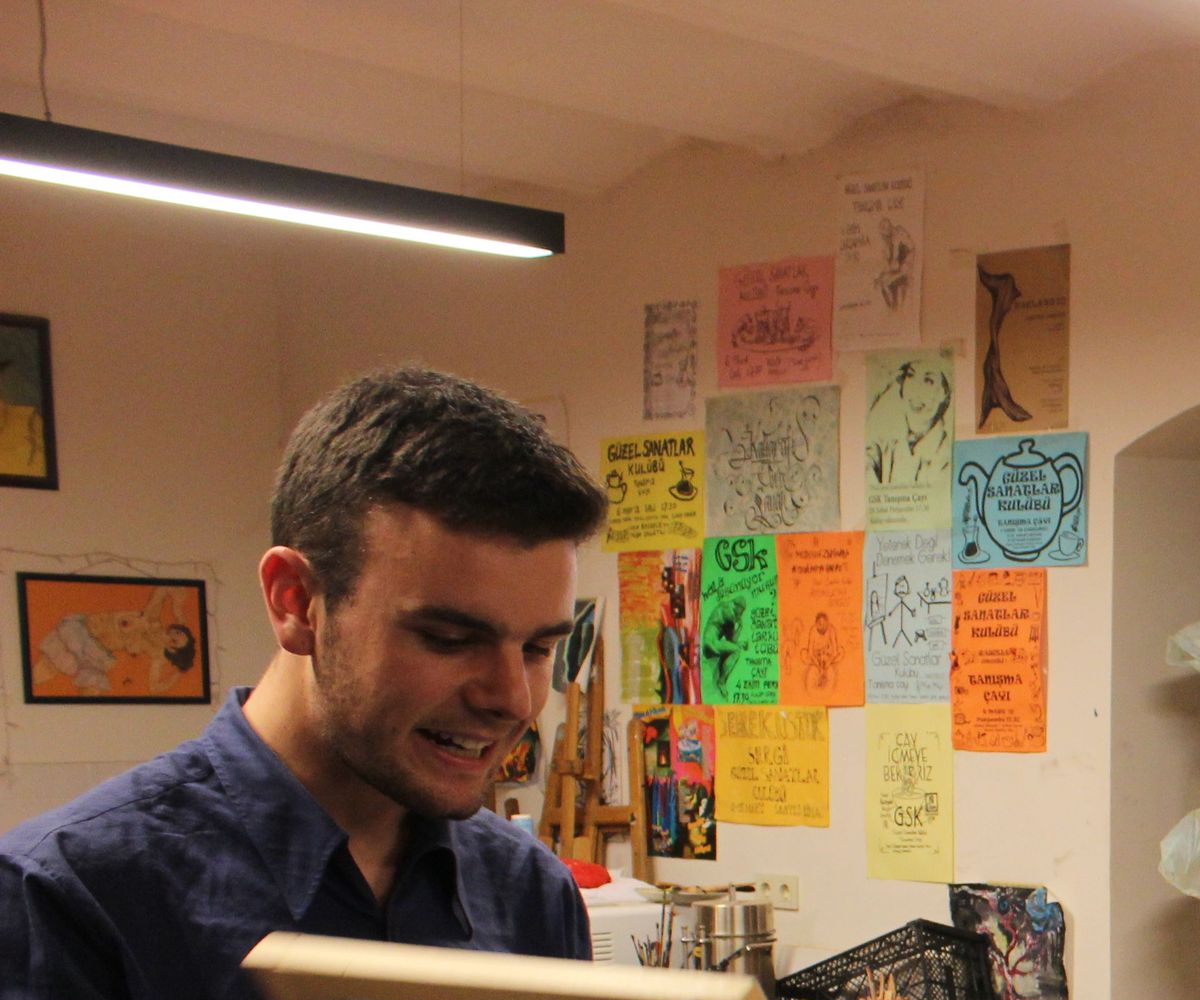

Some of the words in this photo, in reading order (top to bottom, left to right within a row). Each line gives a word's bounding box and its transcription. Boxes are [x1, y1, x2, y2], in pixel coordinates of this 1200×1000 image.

[642, 436, 695, 458] SANATLAR
[1002, 468, 1047, 485] GÜZEL
[987, 482, 1060, 498] SANATLAR
[998, 497, 1051, 512] KULÜBÜ
[977, 591, 1017, 604] GÜZEL
[963, 608, 1030, 622] SANATLAR
[971, 623, 1019, 639] KULÜBÜ
[893, 805, 923, 827] GSK
